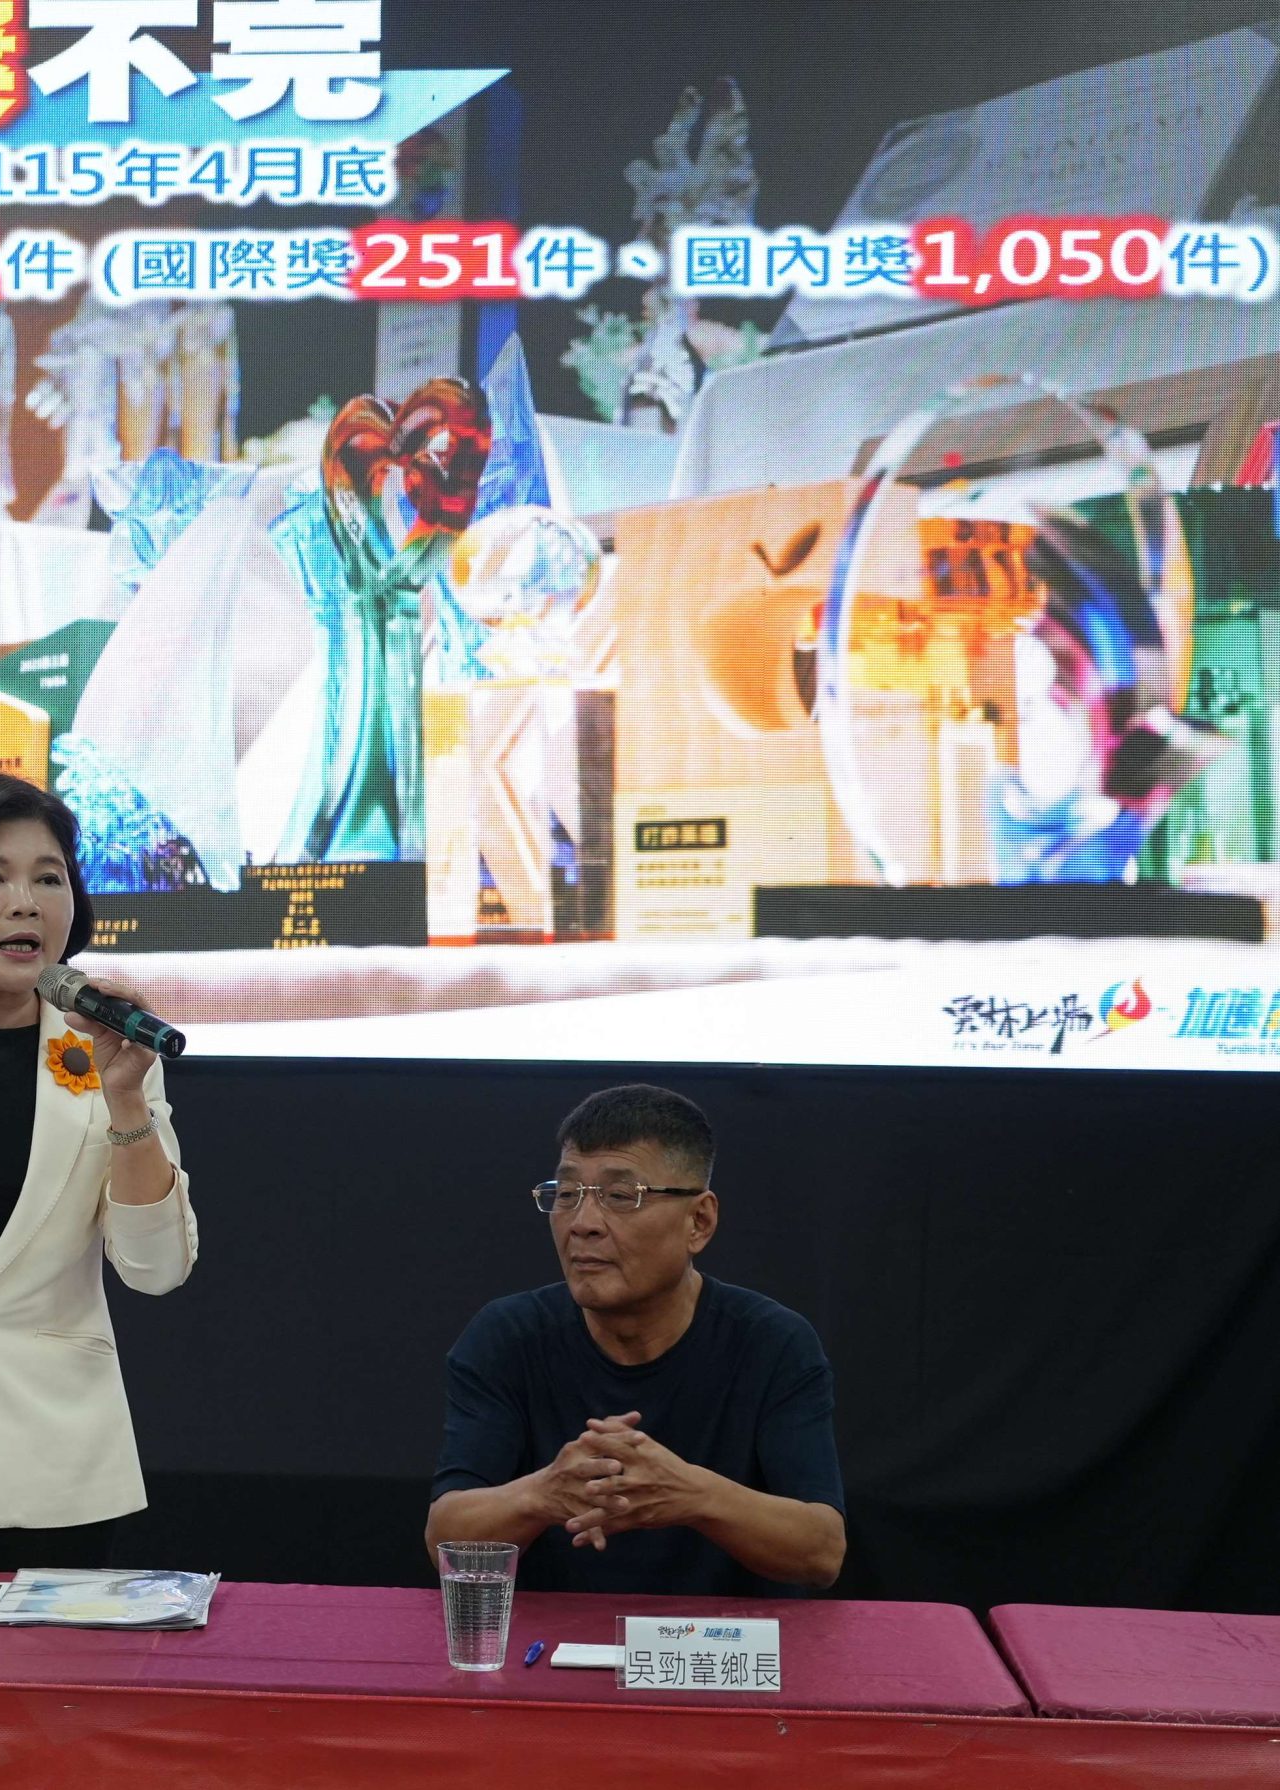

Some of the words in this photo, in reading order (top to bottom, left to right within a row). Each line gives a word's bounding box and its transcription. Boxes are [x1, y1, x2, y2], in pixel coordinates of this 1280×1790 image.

[627, 1650, 780, 1687] 吳勁葦鄉長
